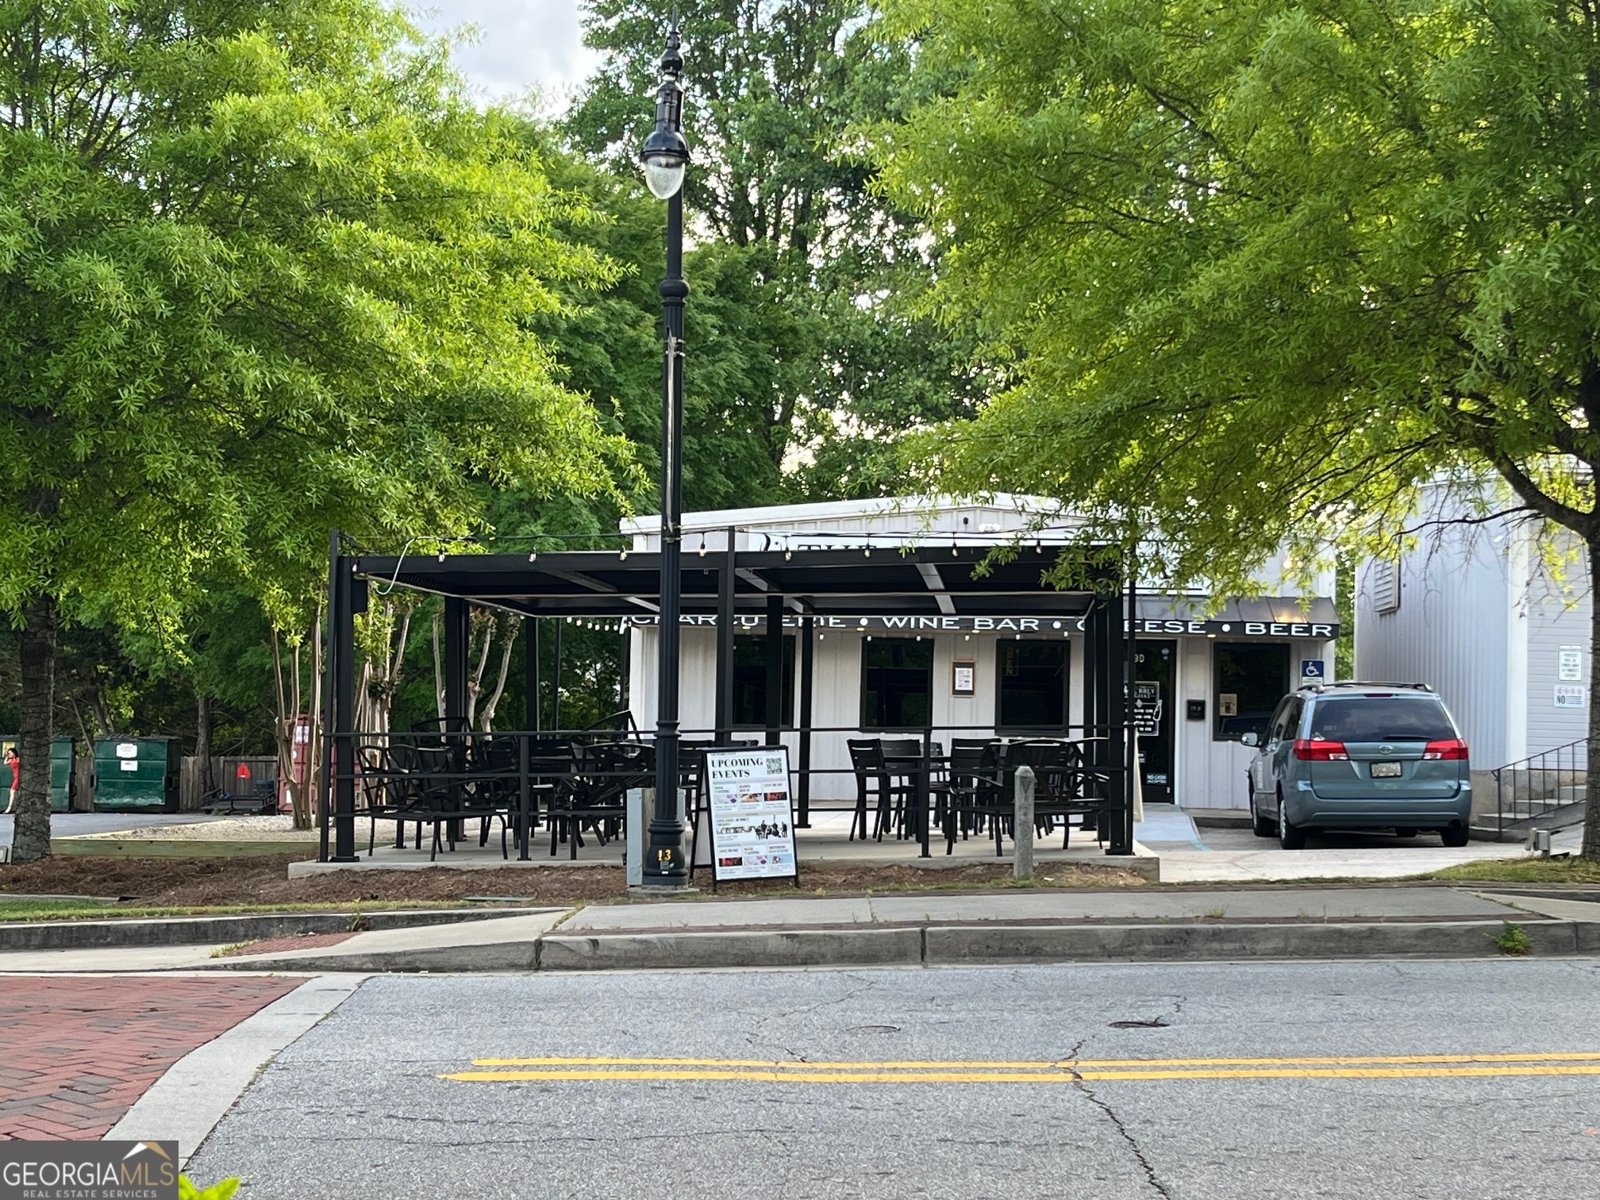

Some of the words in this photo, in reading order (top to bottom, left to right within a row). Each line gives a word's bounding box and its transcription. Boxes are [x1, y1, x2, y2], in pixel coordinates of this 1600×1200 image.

[631, 615, 847, 628] CARUEIE
[882, 617, 960, 630] WINE
[974, 618, 1040, 631] BAR
[1076, 619, 1207, 634] CEESE
[1245, 623, 1333, 637] BEER
[711, 757, 763, 769] UPCOMING
[712, 769, 750, 780] EVENTS
[657, 849, 672, 861] 13
